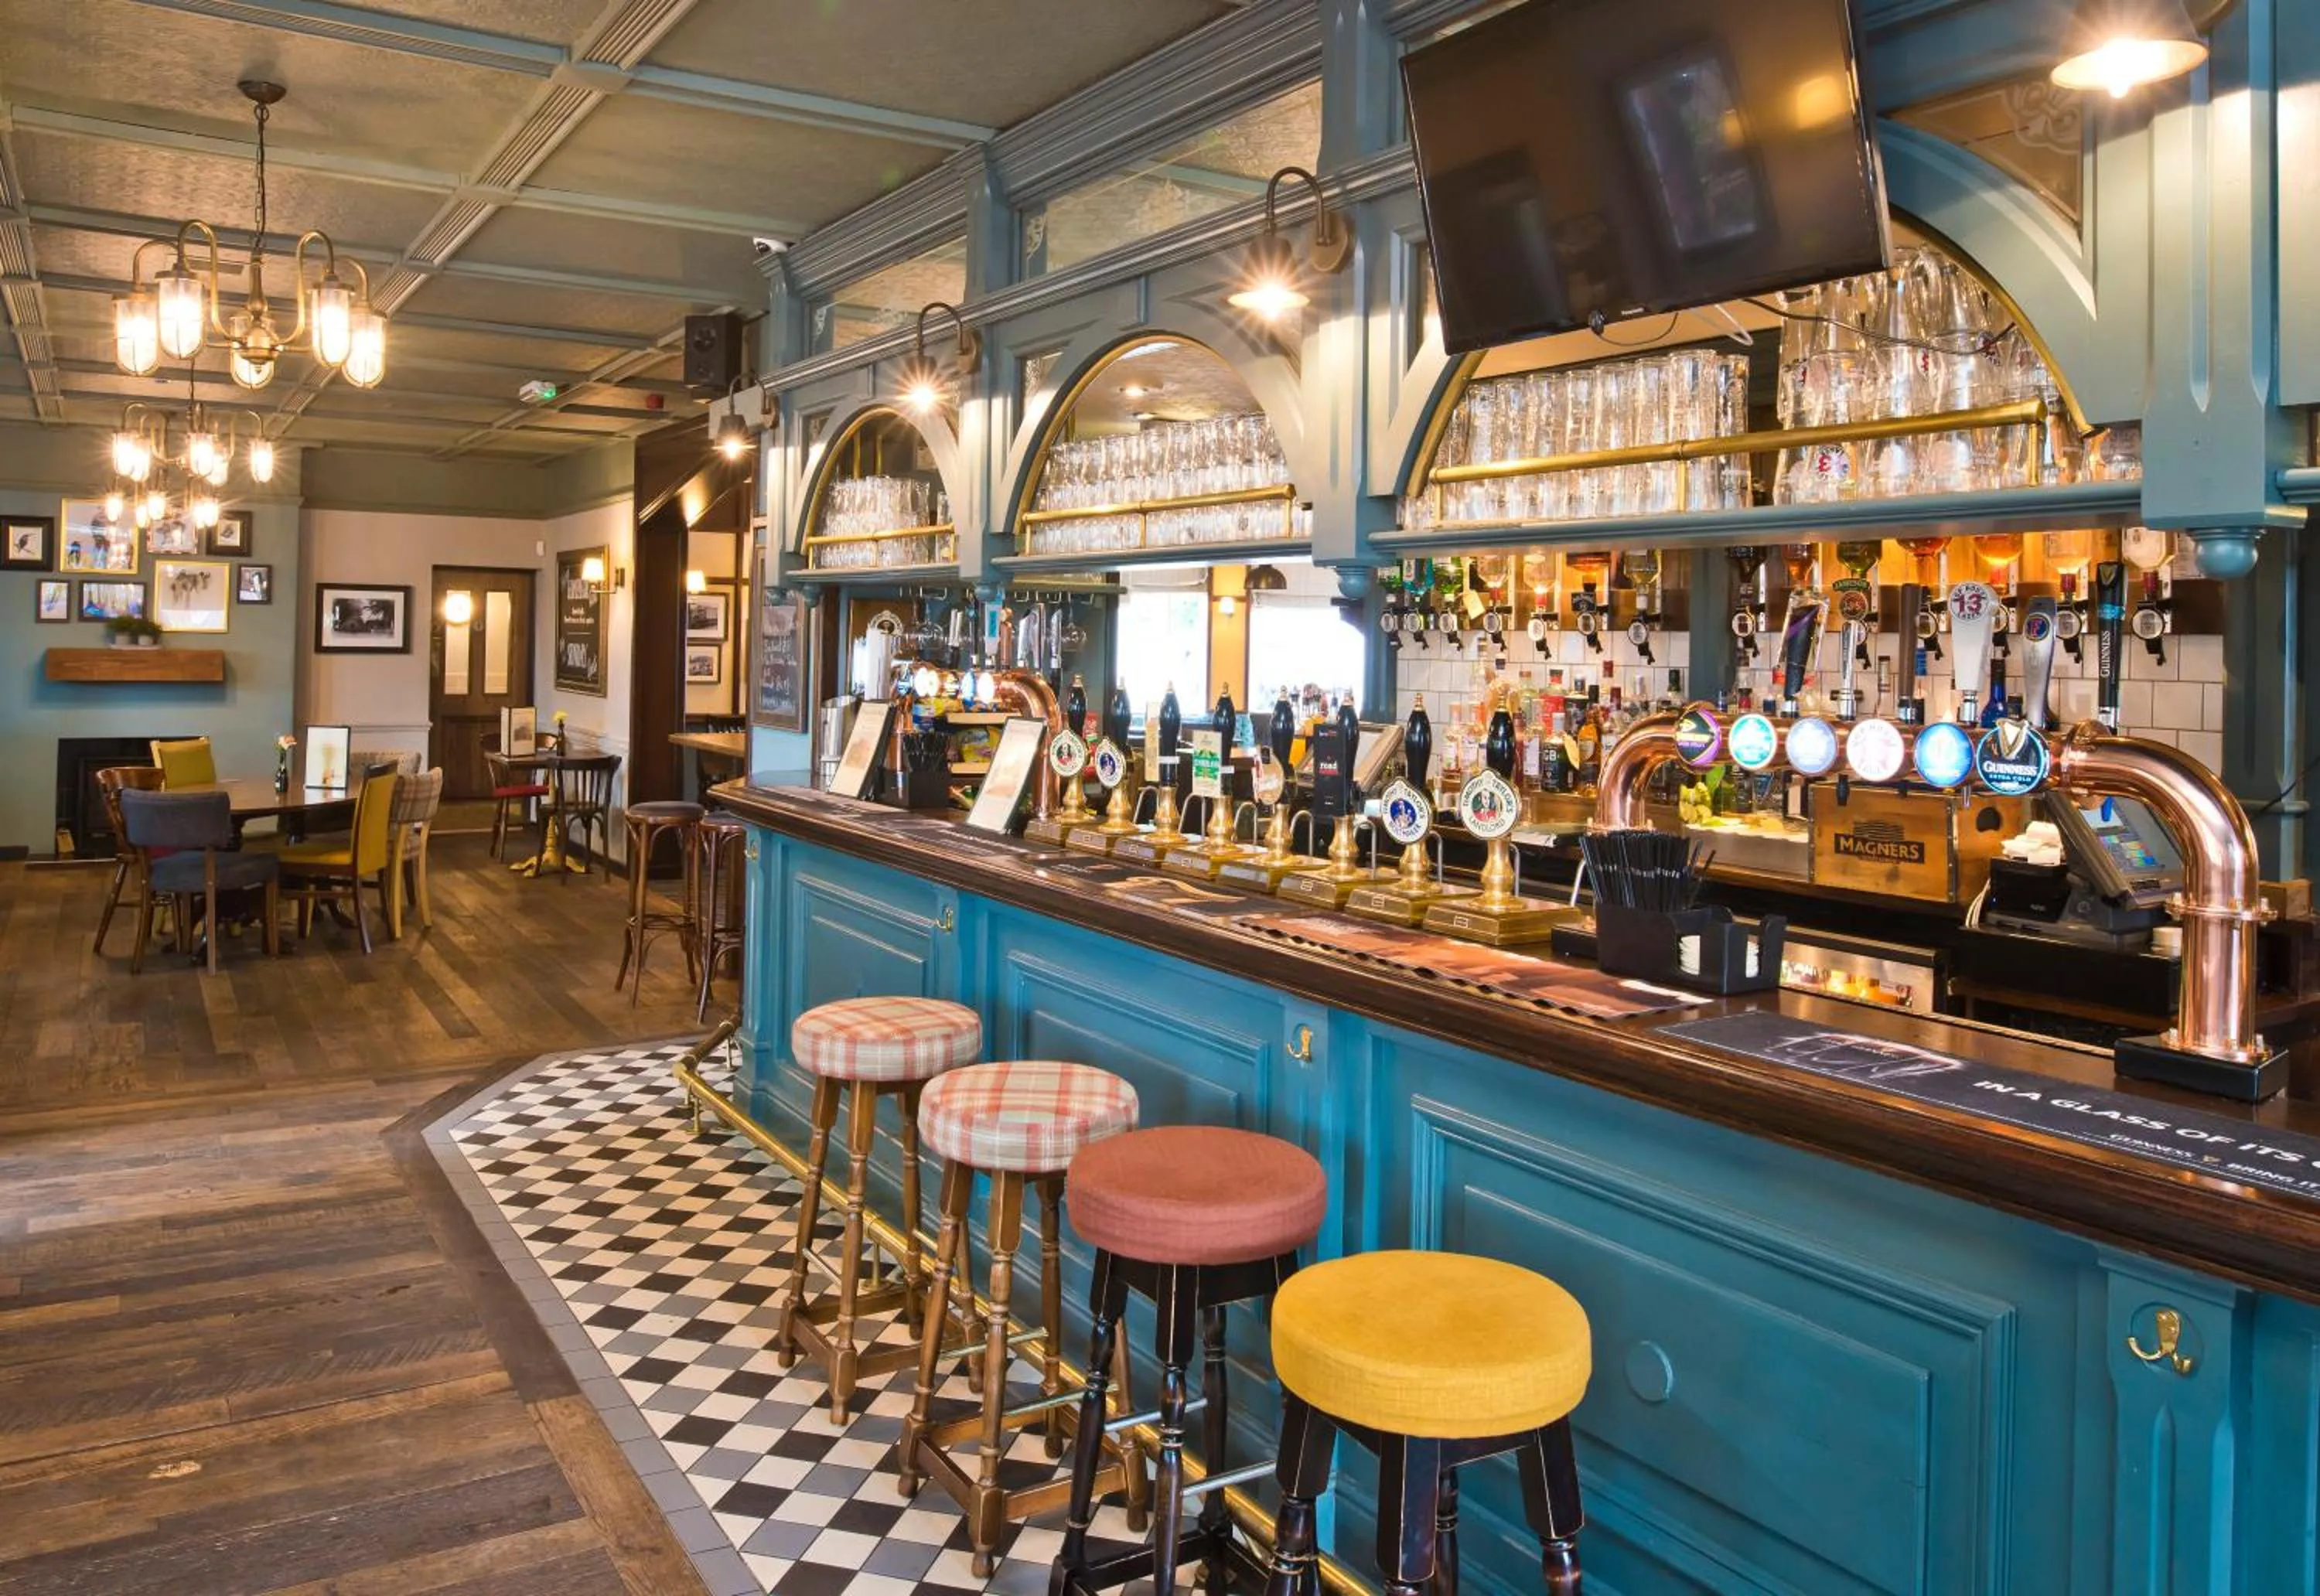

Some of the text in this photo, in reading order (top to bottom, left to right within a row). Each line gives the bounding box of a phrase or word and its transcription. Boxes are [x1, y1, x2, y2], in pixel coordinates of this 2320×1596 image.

[1957, 593, 1982, 613] 13
[2100, 630, 2110, 678] GUINNESS
[1983, 761, 2039, 776] GUINNESS
[1469, 816, 1506, 834] LANDLORD
[1840, 835, 1919, 860] MAGNERS
[1973, 1080, 2306, 1162] IN A GLASS OF ITS
